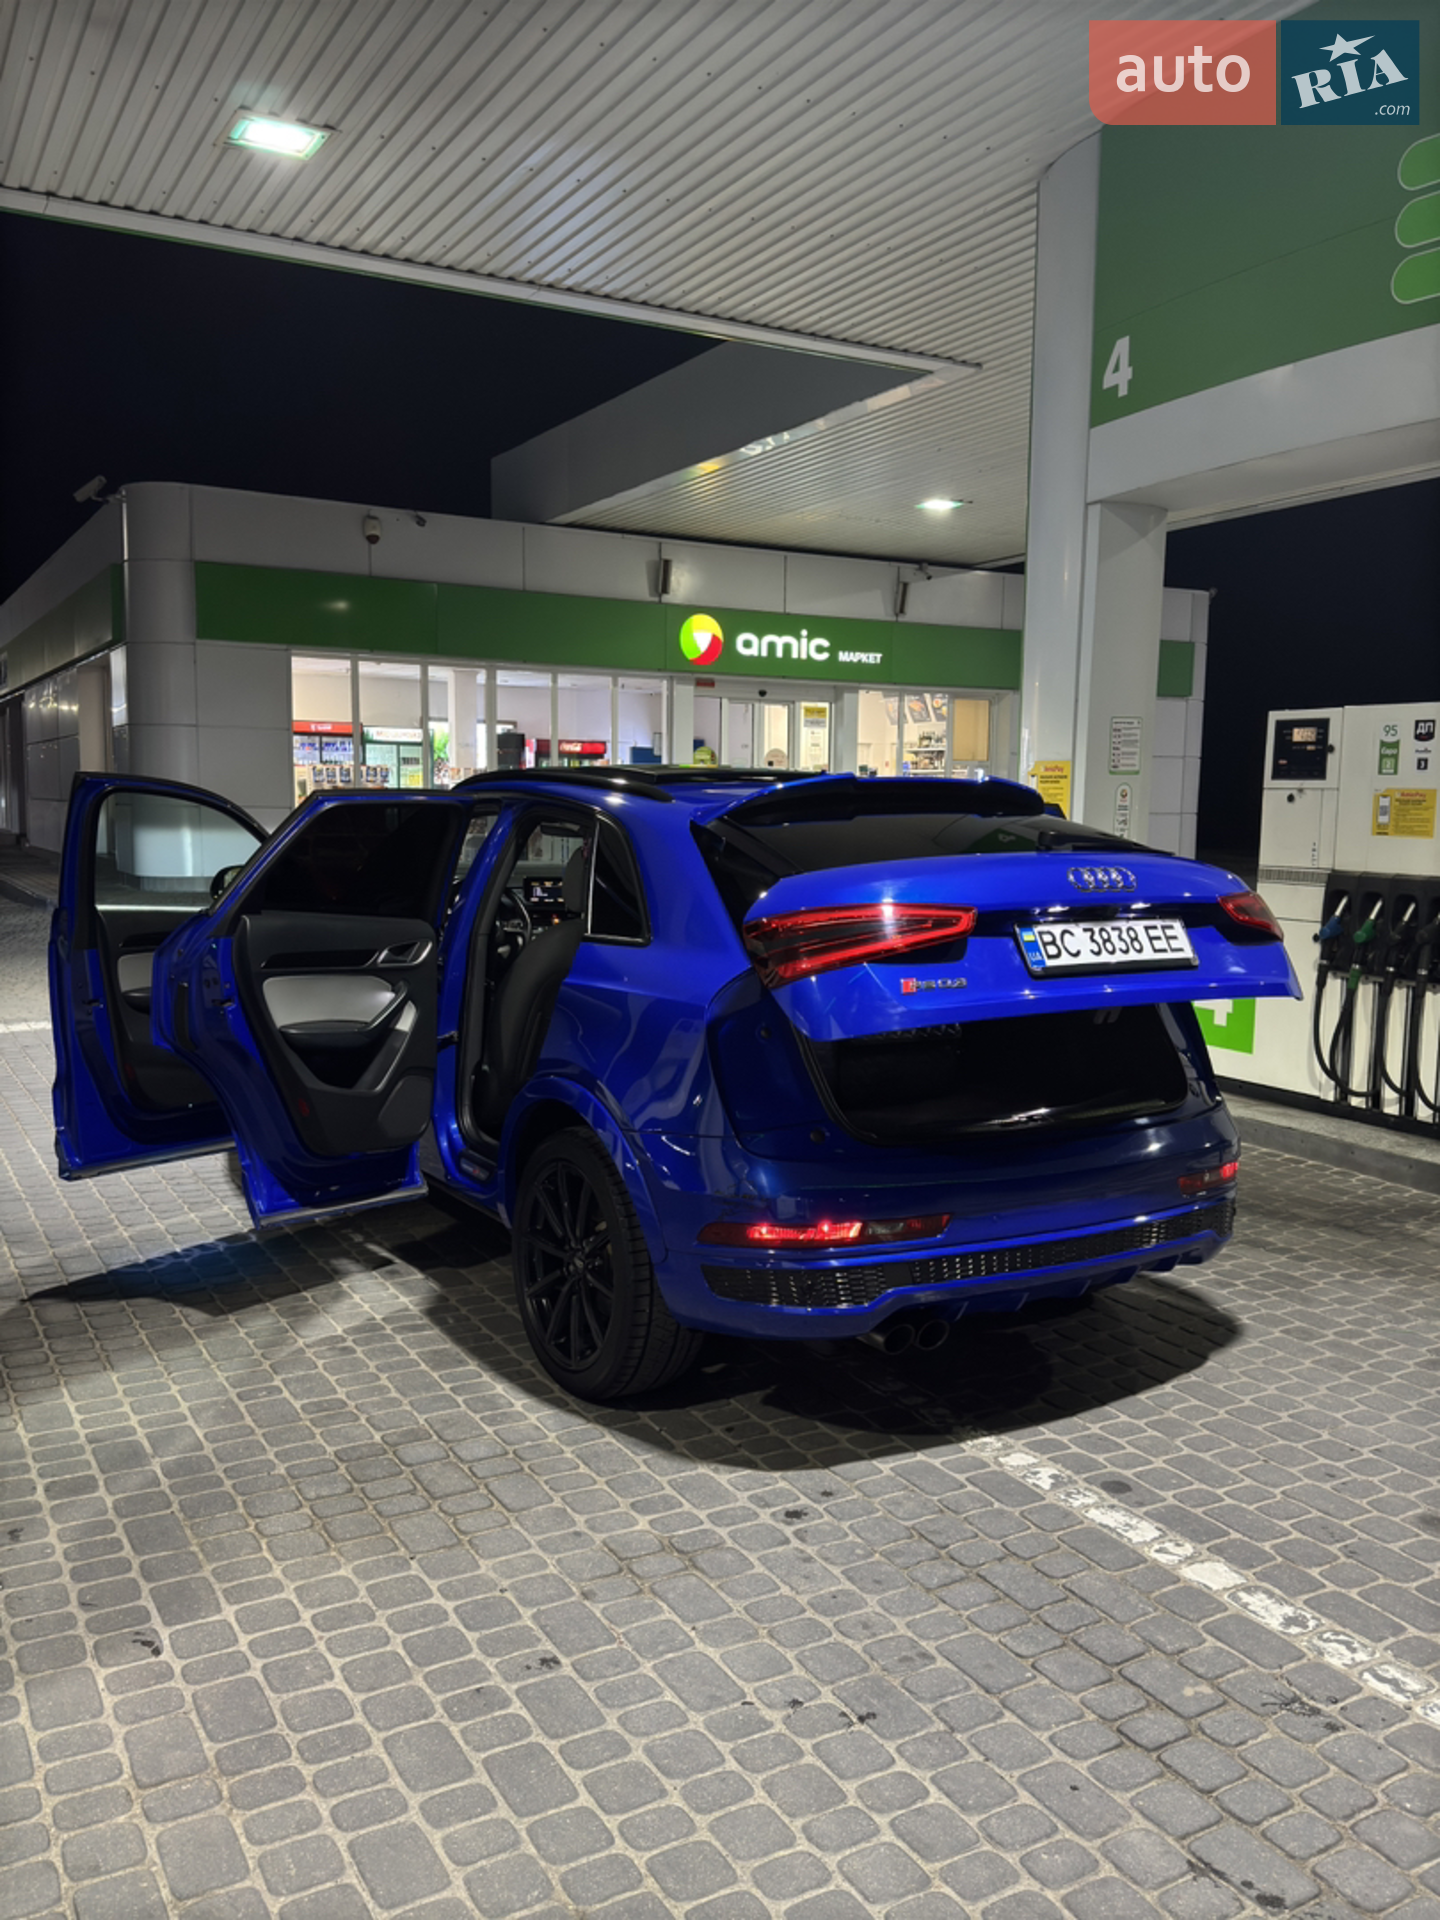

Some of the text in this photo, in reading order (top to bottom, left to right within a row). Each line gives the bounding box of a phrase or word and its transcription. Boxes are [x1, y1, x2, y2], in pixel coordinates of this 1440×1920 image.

[1102, 335, 1133, 398] 4
[735, 628, 831, 662] amic
[838, 650, 883, 664] МАРКЕТ
[1382, 724, 1398, 737] 95
[1416, 721, 1434, 735] ДП
[1037, 924, 1185, 960] BC 3838 EE
